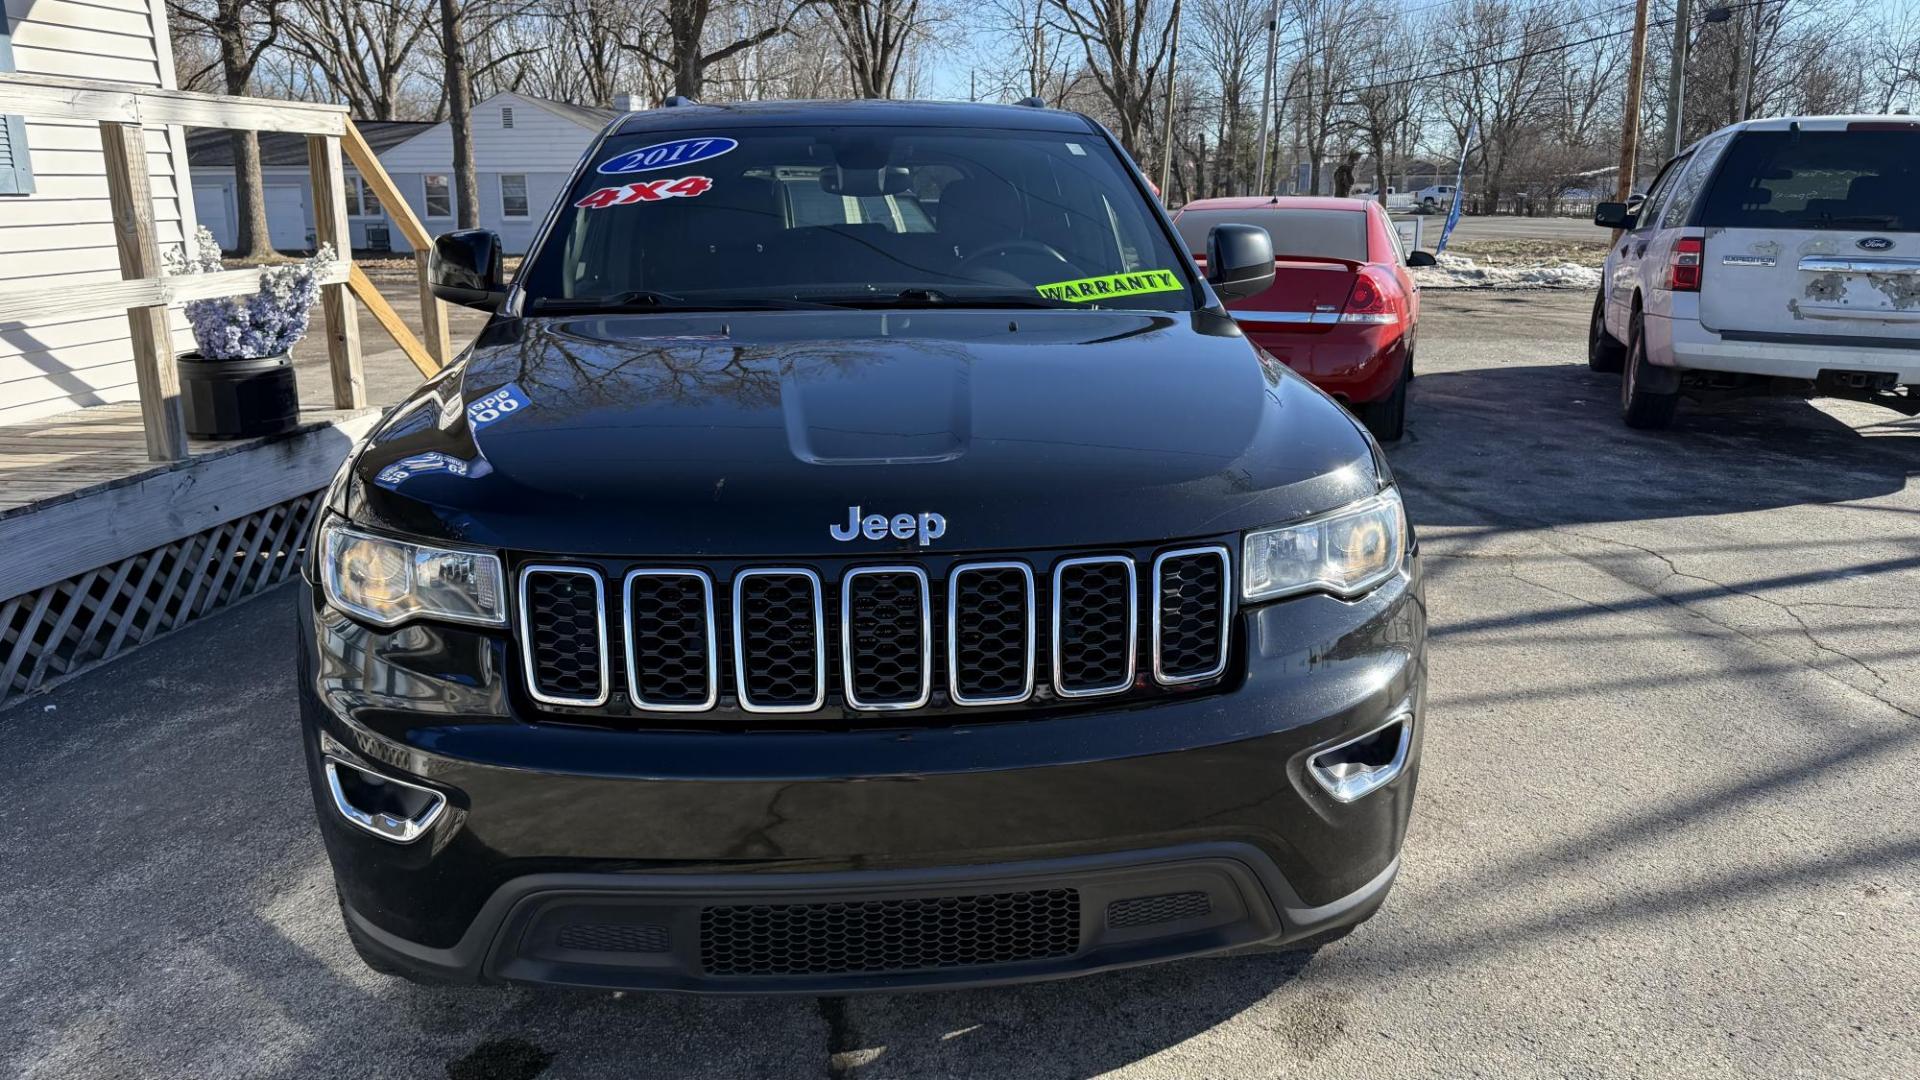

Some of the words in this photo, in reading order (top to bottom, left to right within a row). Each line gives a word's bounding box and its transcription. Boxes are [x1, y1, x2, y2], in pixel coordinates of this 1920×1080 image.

[618, 140, 714, 172] 2017
[1041, 272, 1173, 301] WARRANTY
[829, 505, 947, 546] Jeep
